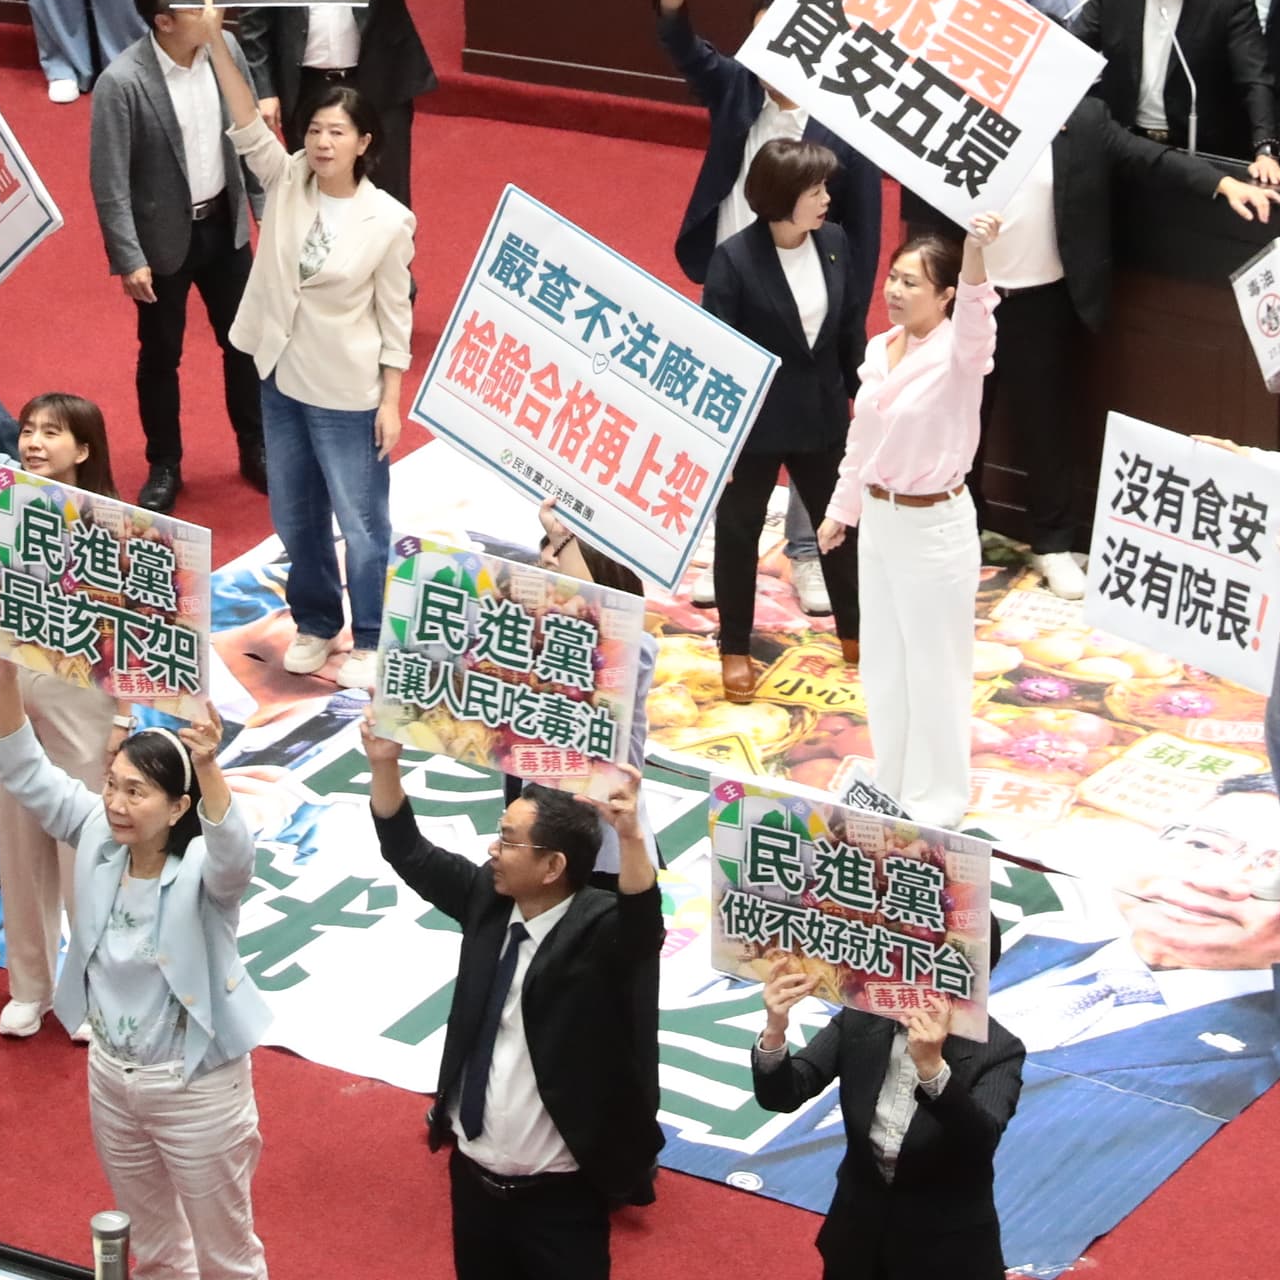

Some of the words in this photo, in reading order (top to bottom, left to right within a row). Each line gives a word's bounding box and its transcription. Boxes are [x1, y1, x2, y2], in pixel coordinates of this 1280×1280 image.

[487, 230, 749, 435] 嚴查不法廠商
[445, 309, 711, 535] 檢驗合格再上架
[512, 456, 596, 522] 民進黨立法院黨團
[1110, 449, 1270, 563] 沒有食安
[19, 504, 178, 612] 民進黨
[1098, 534, 1270, 652] 沒有院長!
[415, 580, 599, 692] 民進黨
[773, 677, 856, 706] 小心
[382, 647, 618, 764] 讓人民吃毒油
[519, 750, 586, 774] 毒蘋果
[746, 822, 946, 934] 民進黨
[720, 890, 976, 1000] 做不好就下台
